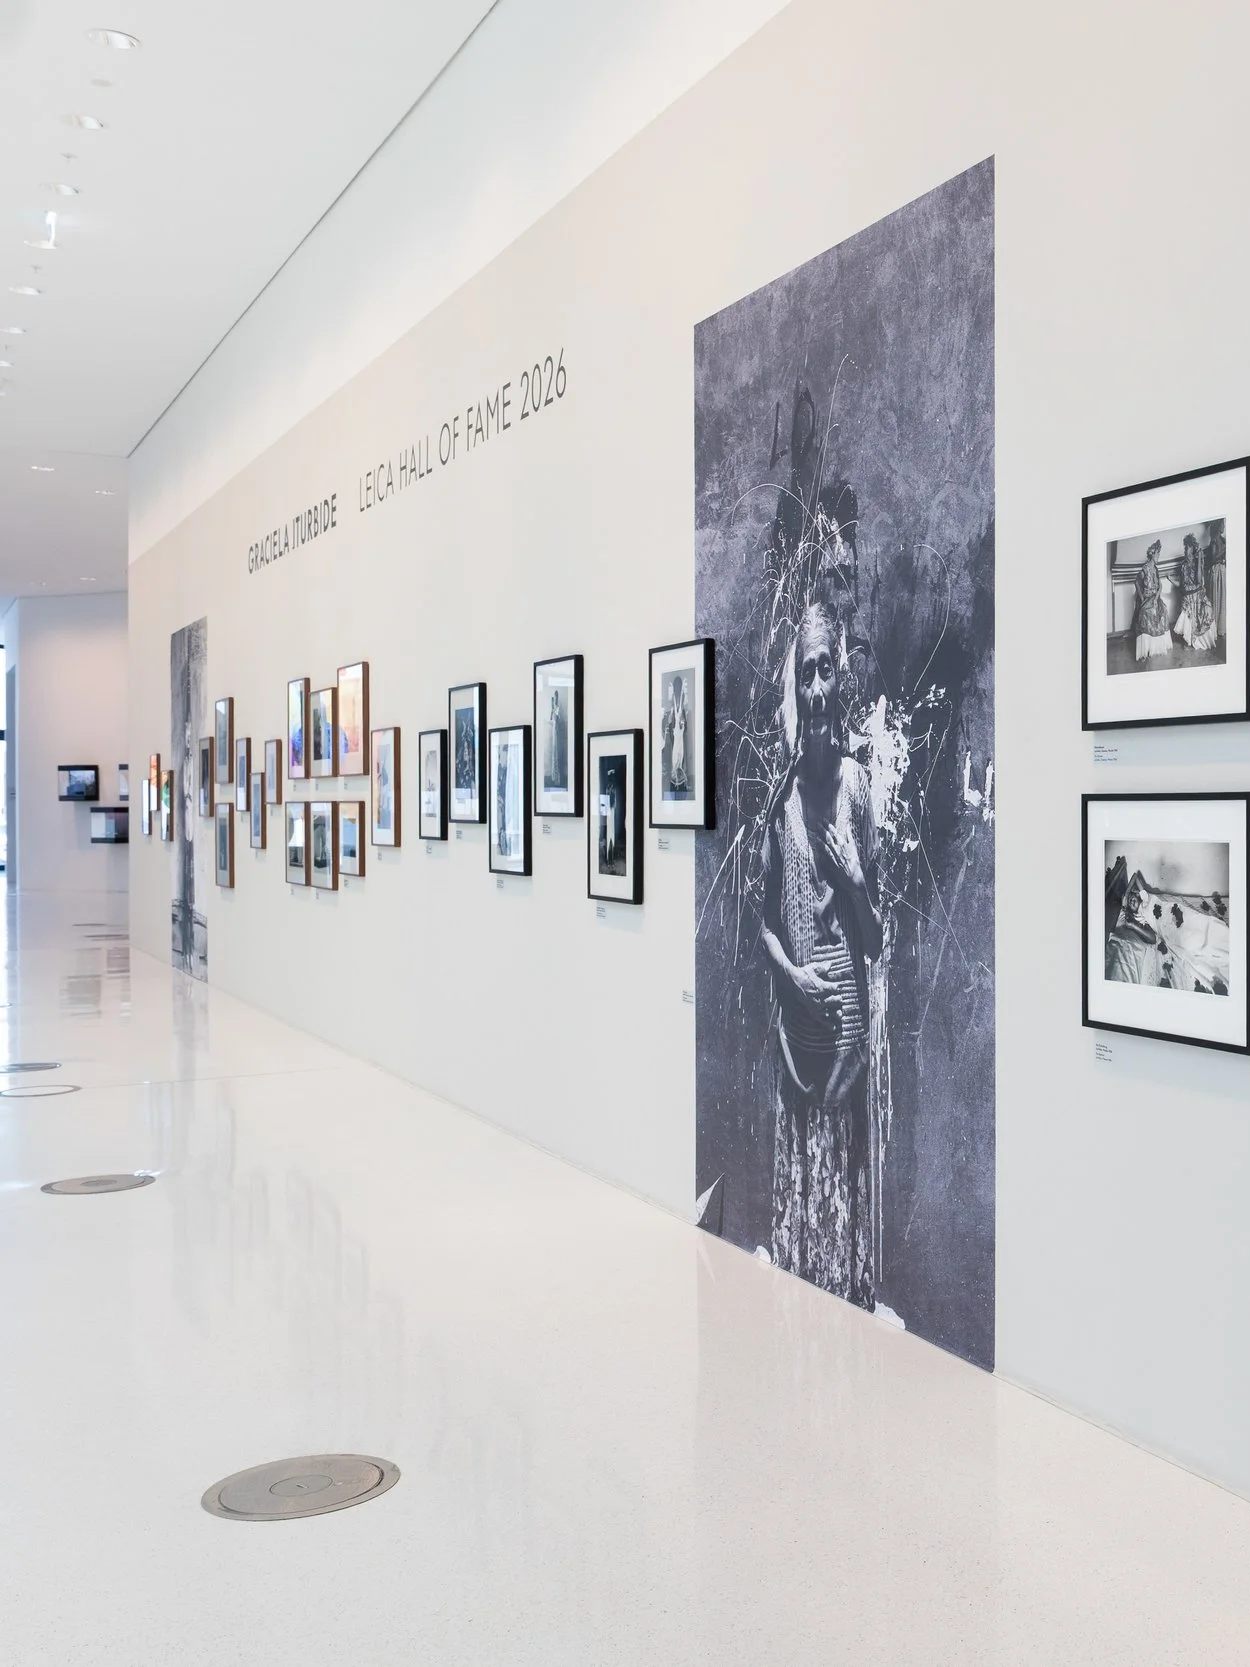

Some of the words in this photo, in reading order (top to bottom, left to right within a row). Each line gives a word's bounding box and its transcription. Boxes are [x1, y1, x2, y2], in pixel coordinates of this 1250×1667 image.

[248, 524, 290, 575] GRACIELA
[359, 459, 395, 513] LEICA
[399, 435, 433, 491] HALL
[439, 415, 460, 466] OF
[467, 381, 512, 452] FAME
[520, 347, 567, 421] 2026
